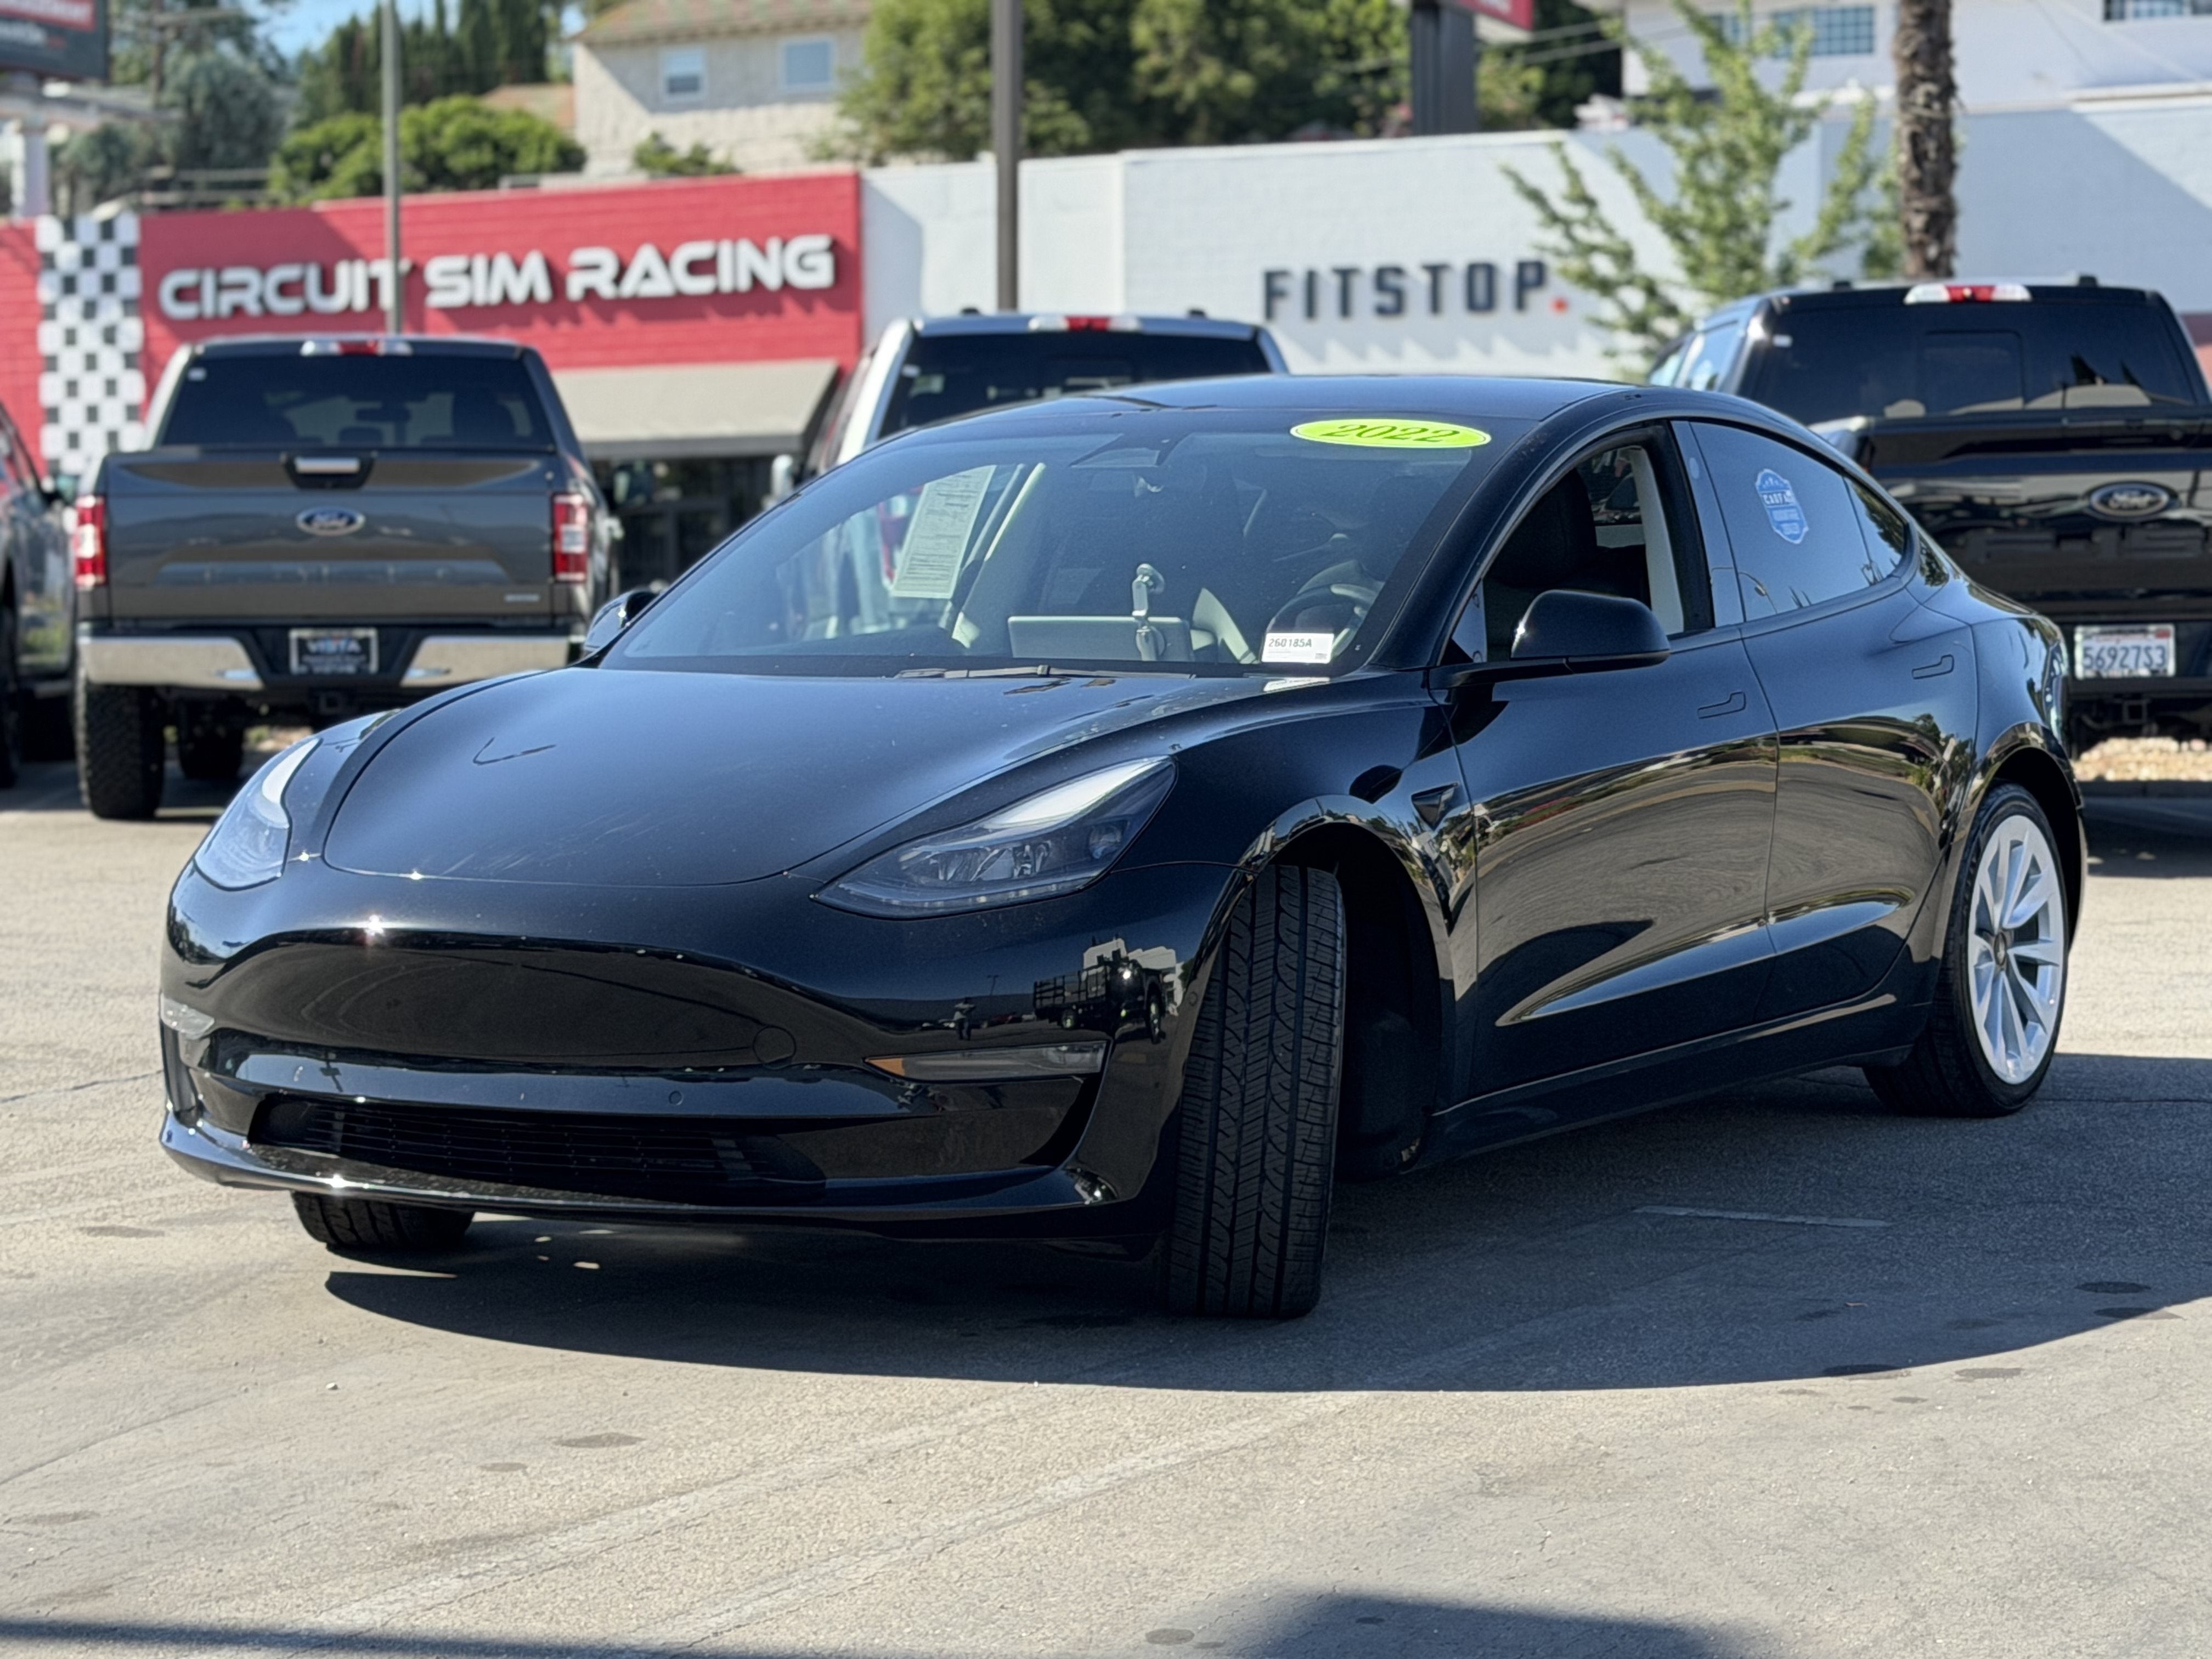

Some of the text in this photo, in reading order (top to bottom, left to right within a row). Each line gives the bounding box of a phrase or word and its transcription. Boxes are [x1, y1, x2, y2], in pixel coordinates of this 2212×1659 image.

[158, 234, 835, 320] CIRCUIT SIM RACING
[1264, 259, 1568, 321] FITSTOP.
[1320, 424, 1460, 442] 2022
[2083, 645, 2166, 669] 56927S3
